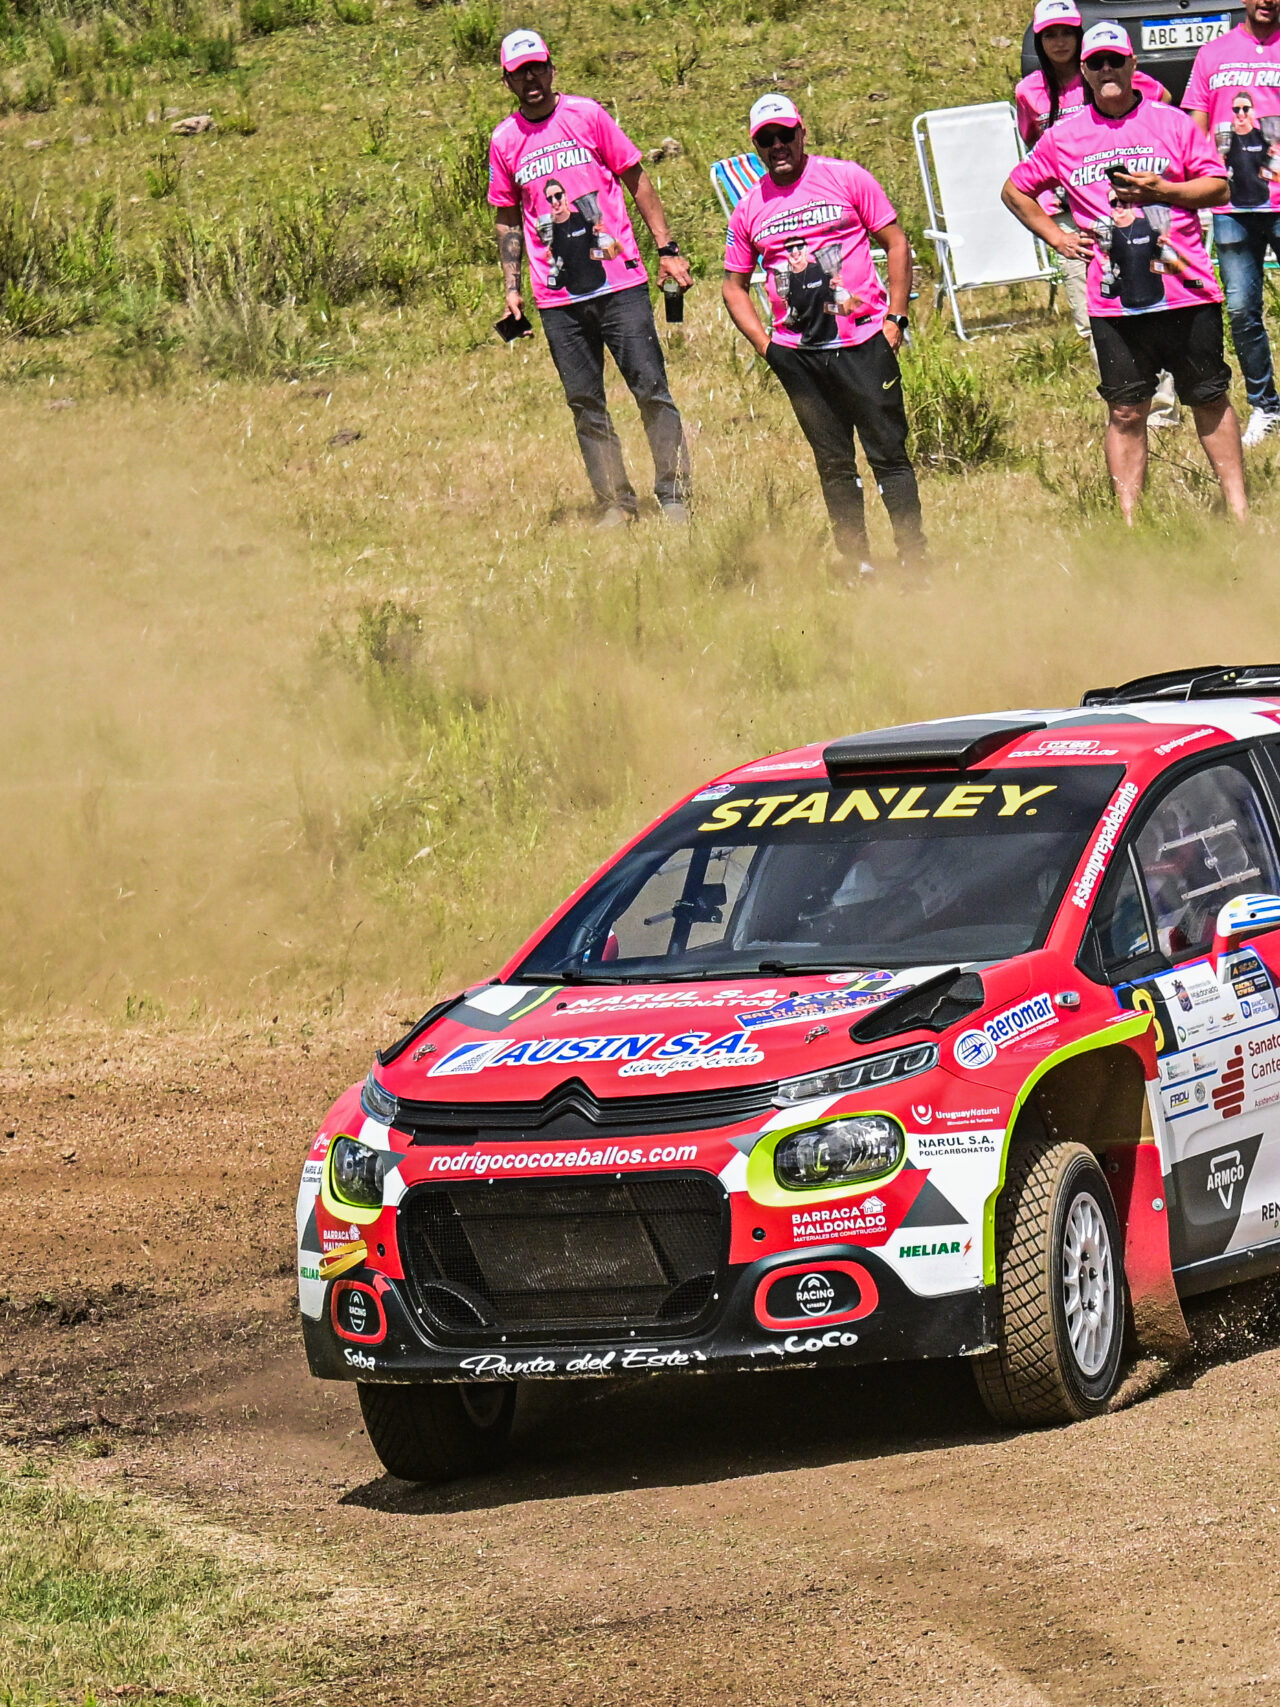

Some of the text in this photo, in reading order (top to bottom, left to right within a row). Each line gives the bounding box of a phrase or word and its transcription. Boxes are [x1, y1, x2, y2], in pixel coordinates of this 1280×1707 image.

[1148, 24, 1224, 46] ABC 1876
[556, 147, 592, 171] RALLY
[801, 204, 844, 229] RALLY
[551, 999, 778, 1017] POLICARBONATOS
[567, 988, 788, 1009] NARUL S.A.
[986, 996, 1052, 1042] aeromar
[491, 1032, 755, 1063] AUSIN S.A.
[622, 1053, 758, 1076] siempre cerca
[918, 1135, 994, 1149] NARUL S.A.
[919, 1146, 996, 1157] POLICARBONATOS
[427, 1144, 698, 1174] rodrigococozeballos.com
[1206, 1163, 1245, 1191] ARMCO
[792, 1207, 861, 1225] BARRACA
[793, 1215, 886, 1237] MALDONADO
[323, 1229, 350, 1240] BARRACA
[793, 1232, 830, 1243] MATERIALES
[839, 1226, 887, 1238] CONSTRUCCIÓN
[899, 1241, 961, 1259] HELIAR
[796, 1288, 835, 1302] RACING
[344, 1349, 376, 1371] Seba
[459, 1348, 691, 1375] Punta del Este
